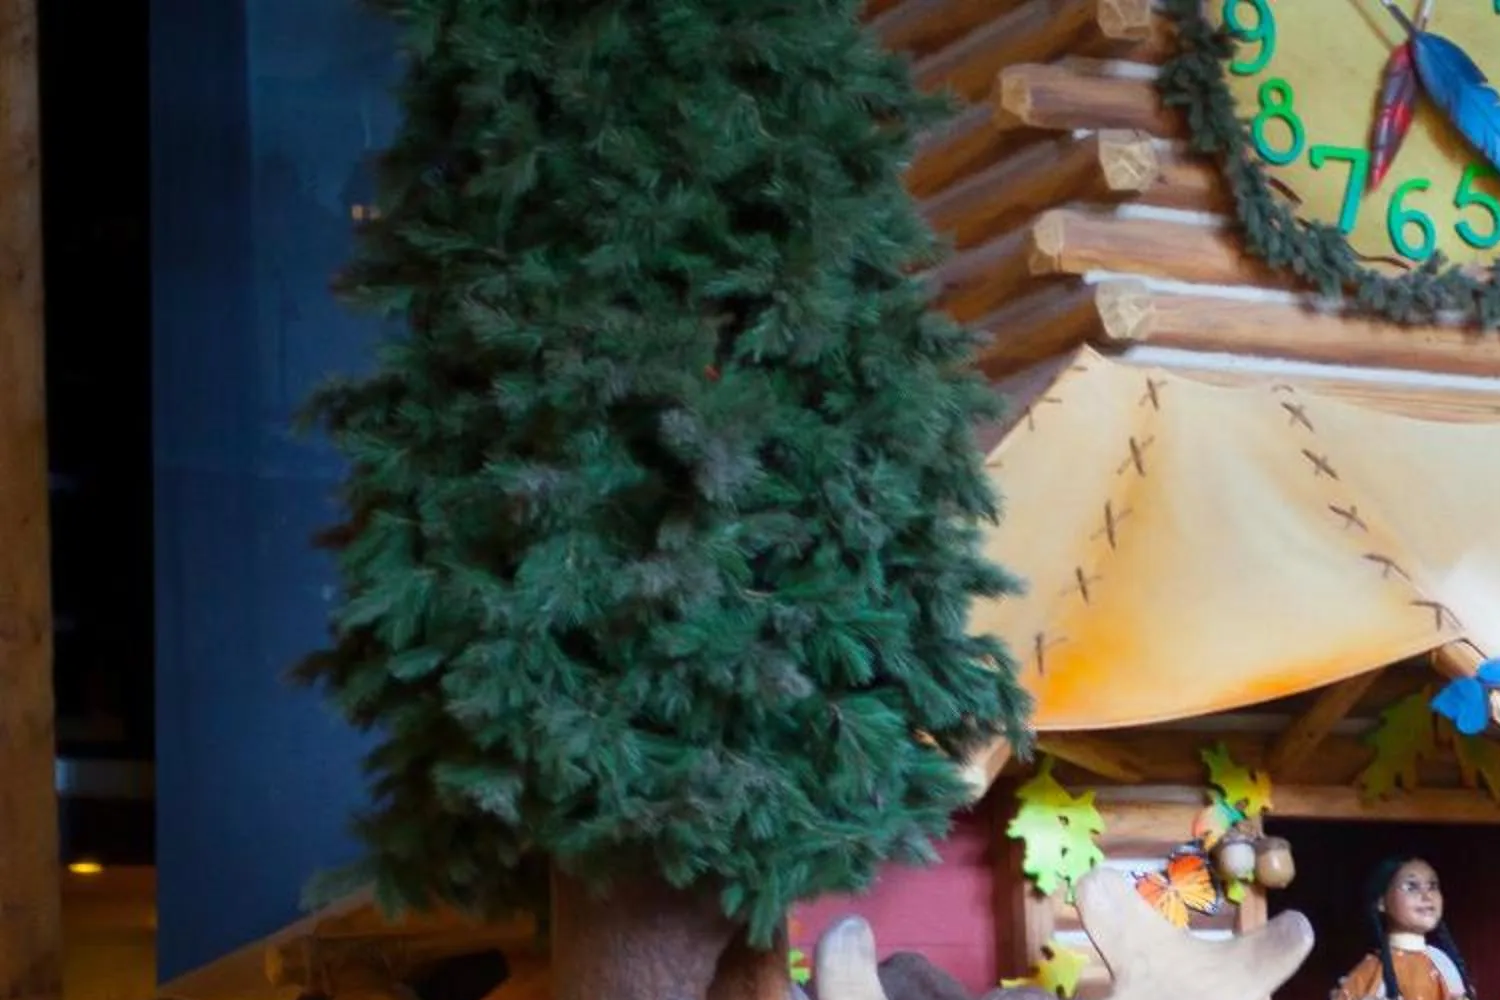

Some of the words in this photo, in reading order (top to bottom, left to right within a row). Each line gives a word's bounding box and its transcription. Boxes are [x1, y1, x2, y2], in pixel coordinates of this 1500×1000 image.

[1223, 0, 1276, 76] 9
[1251, 78, 1305, 165] 8
[1309, 144, 1369, 235] 7
[1387, 178, 1437, 262] 6
